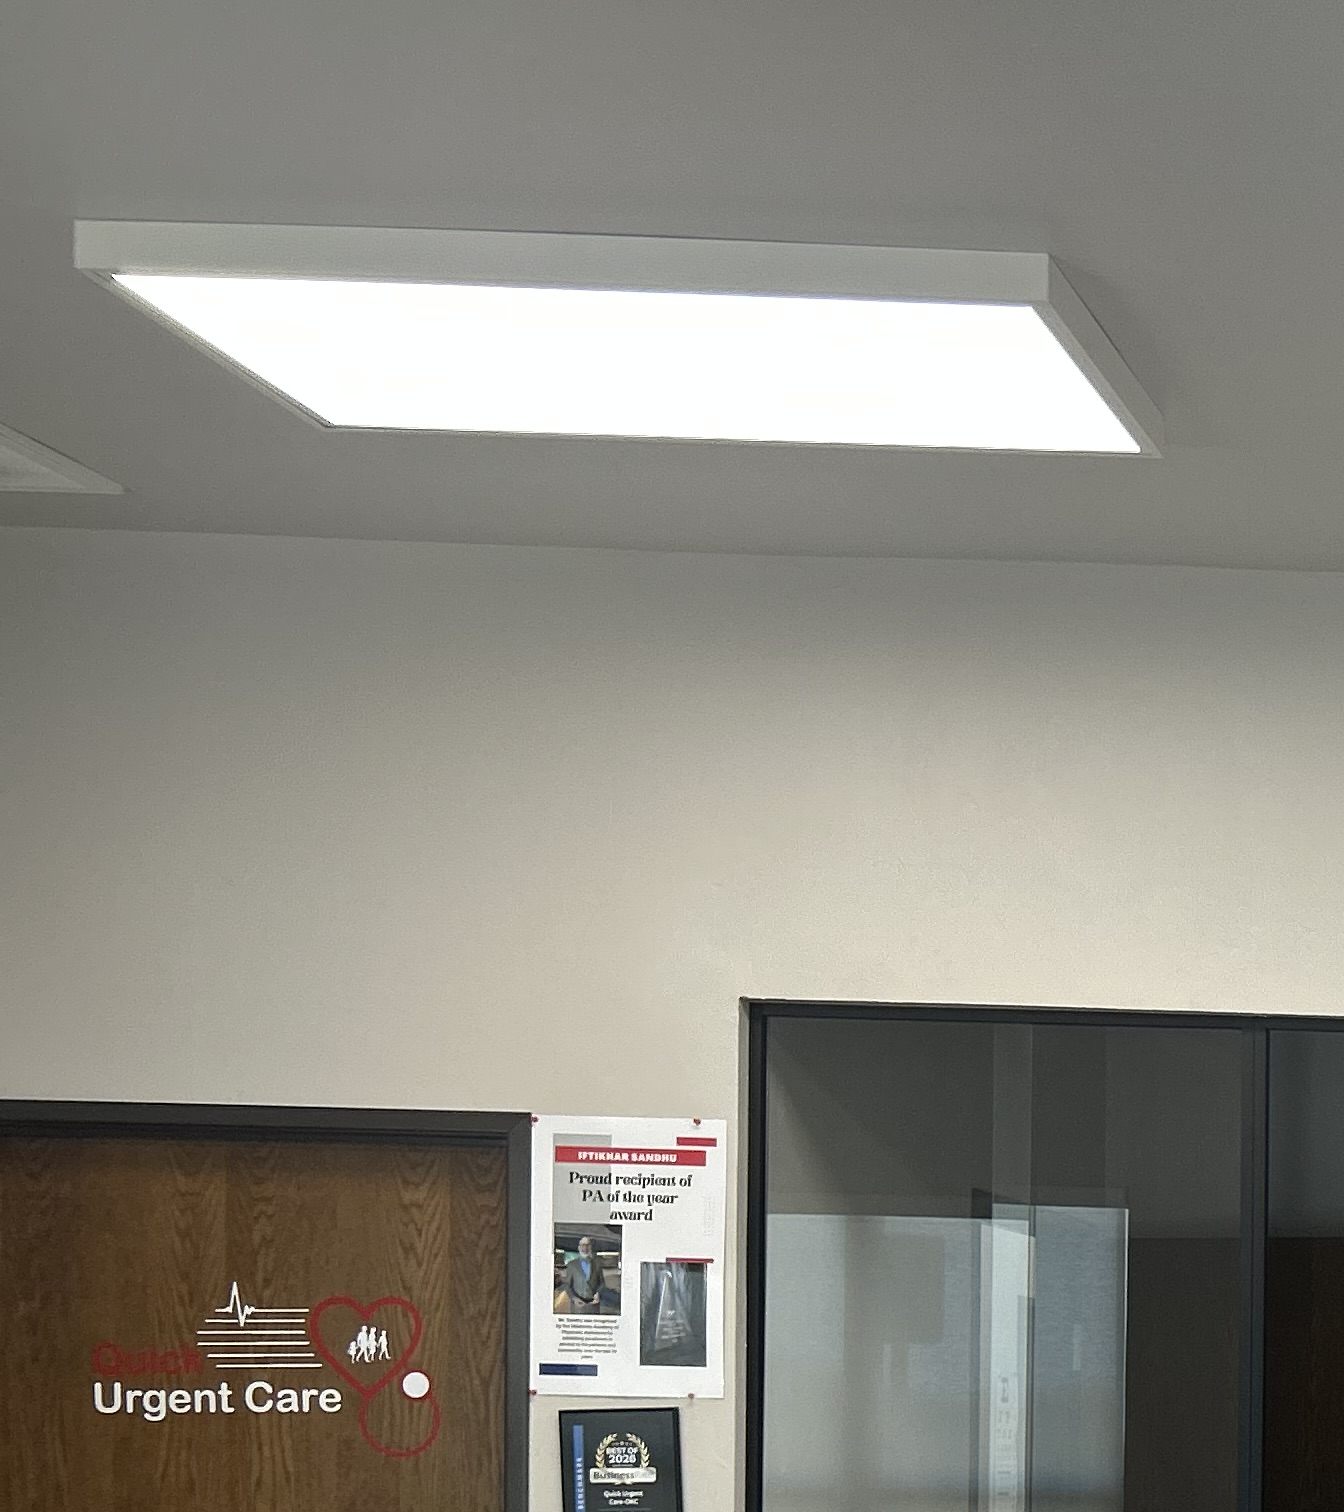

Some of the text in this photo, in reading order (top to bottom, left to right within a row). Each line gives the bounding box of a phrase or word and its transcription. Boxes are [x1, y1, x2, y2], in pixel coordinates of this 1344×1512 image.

[569, 1172, 693, 1188] Proud recipient of
[582, 1190, 678, 1207] PA of the year
[610, 1209, 653, 1221] award
[91, 1341, 205, 1376] Quick
[93, 1380, 342, 1422] Urgent Care
